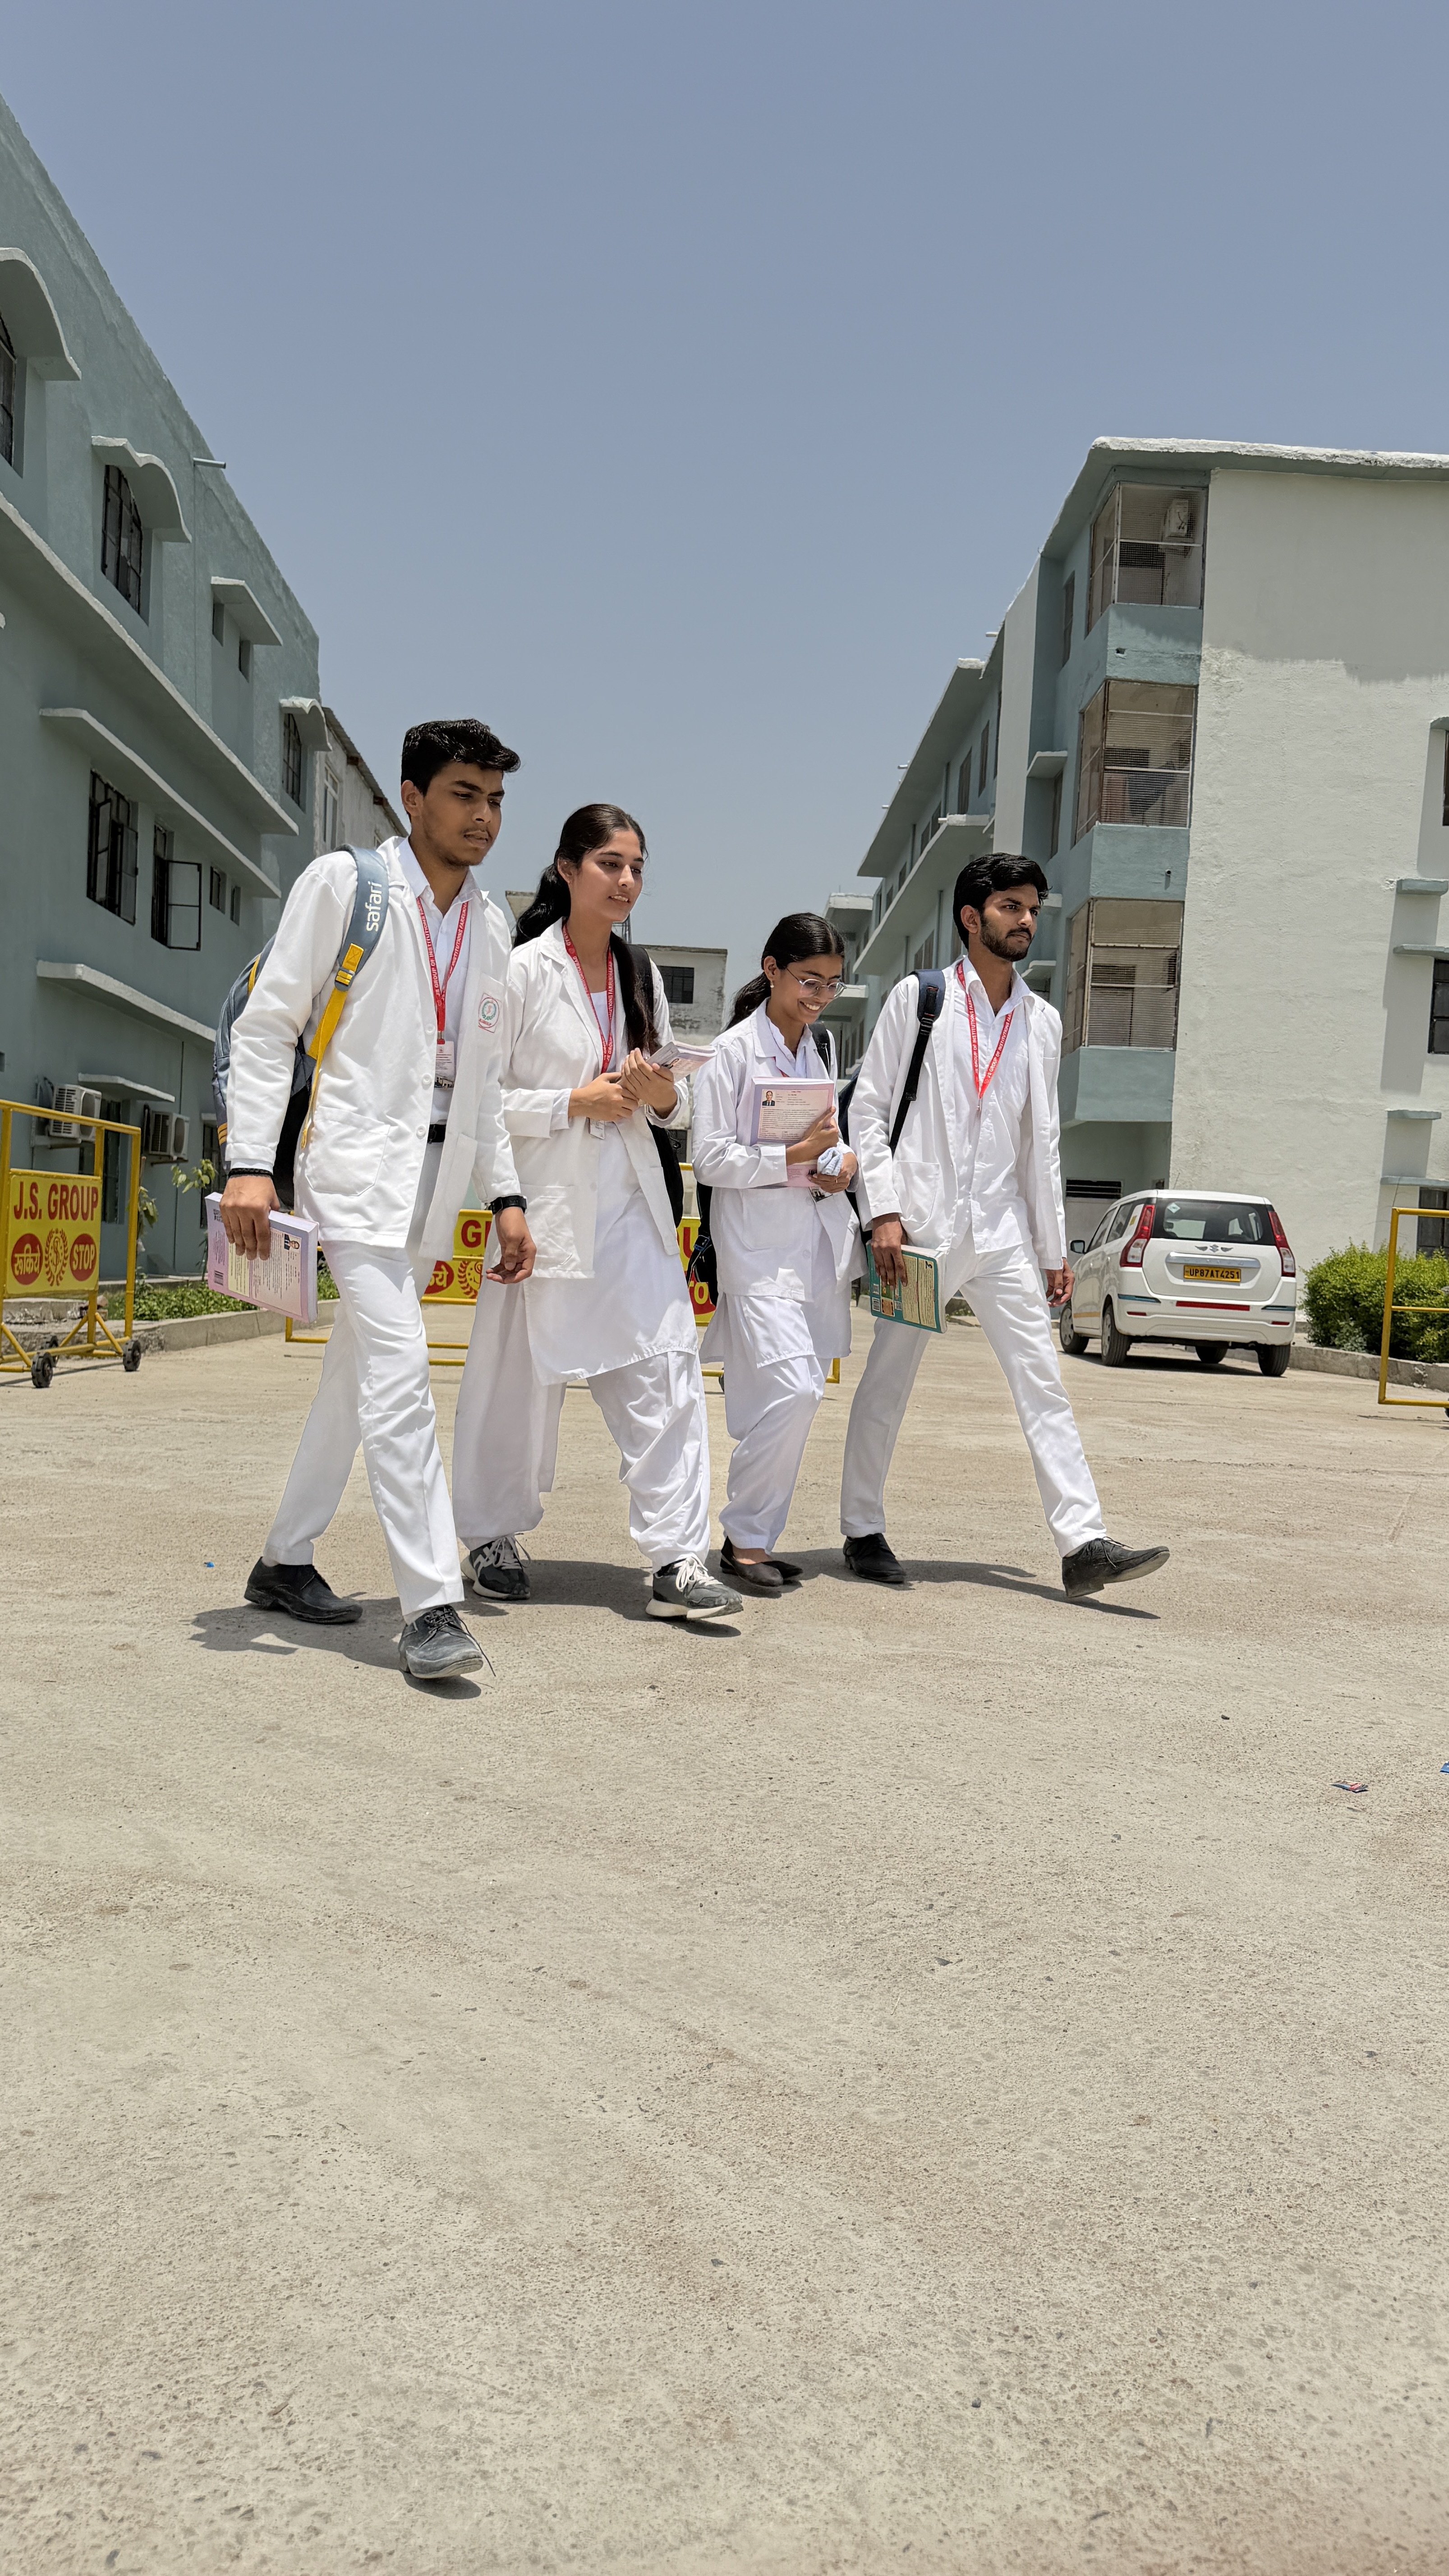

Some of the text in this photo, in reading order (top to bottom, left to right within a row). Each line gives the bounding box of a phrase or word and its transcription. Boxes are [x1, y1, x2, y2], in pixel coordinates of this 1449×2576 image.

[365, 880, 382, 932] safari
[14, 1181, 99, 1221] J.S. GROUP
[72, 1244, 95, 1270] STOP
[1189, 1268, 1240, 1279] UP87AT4251
